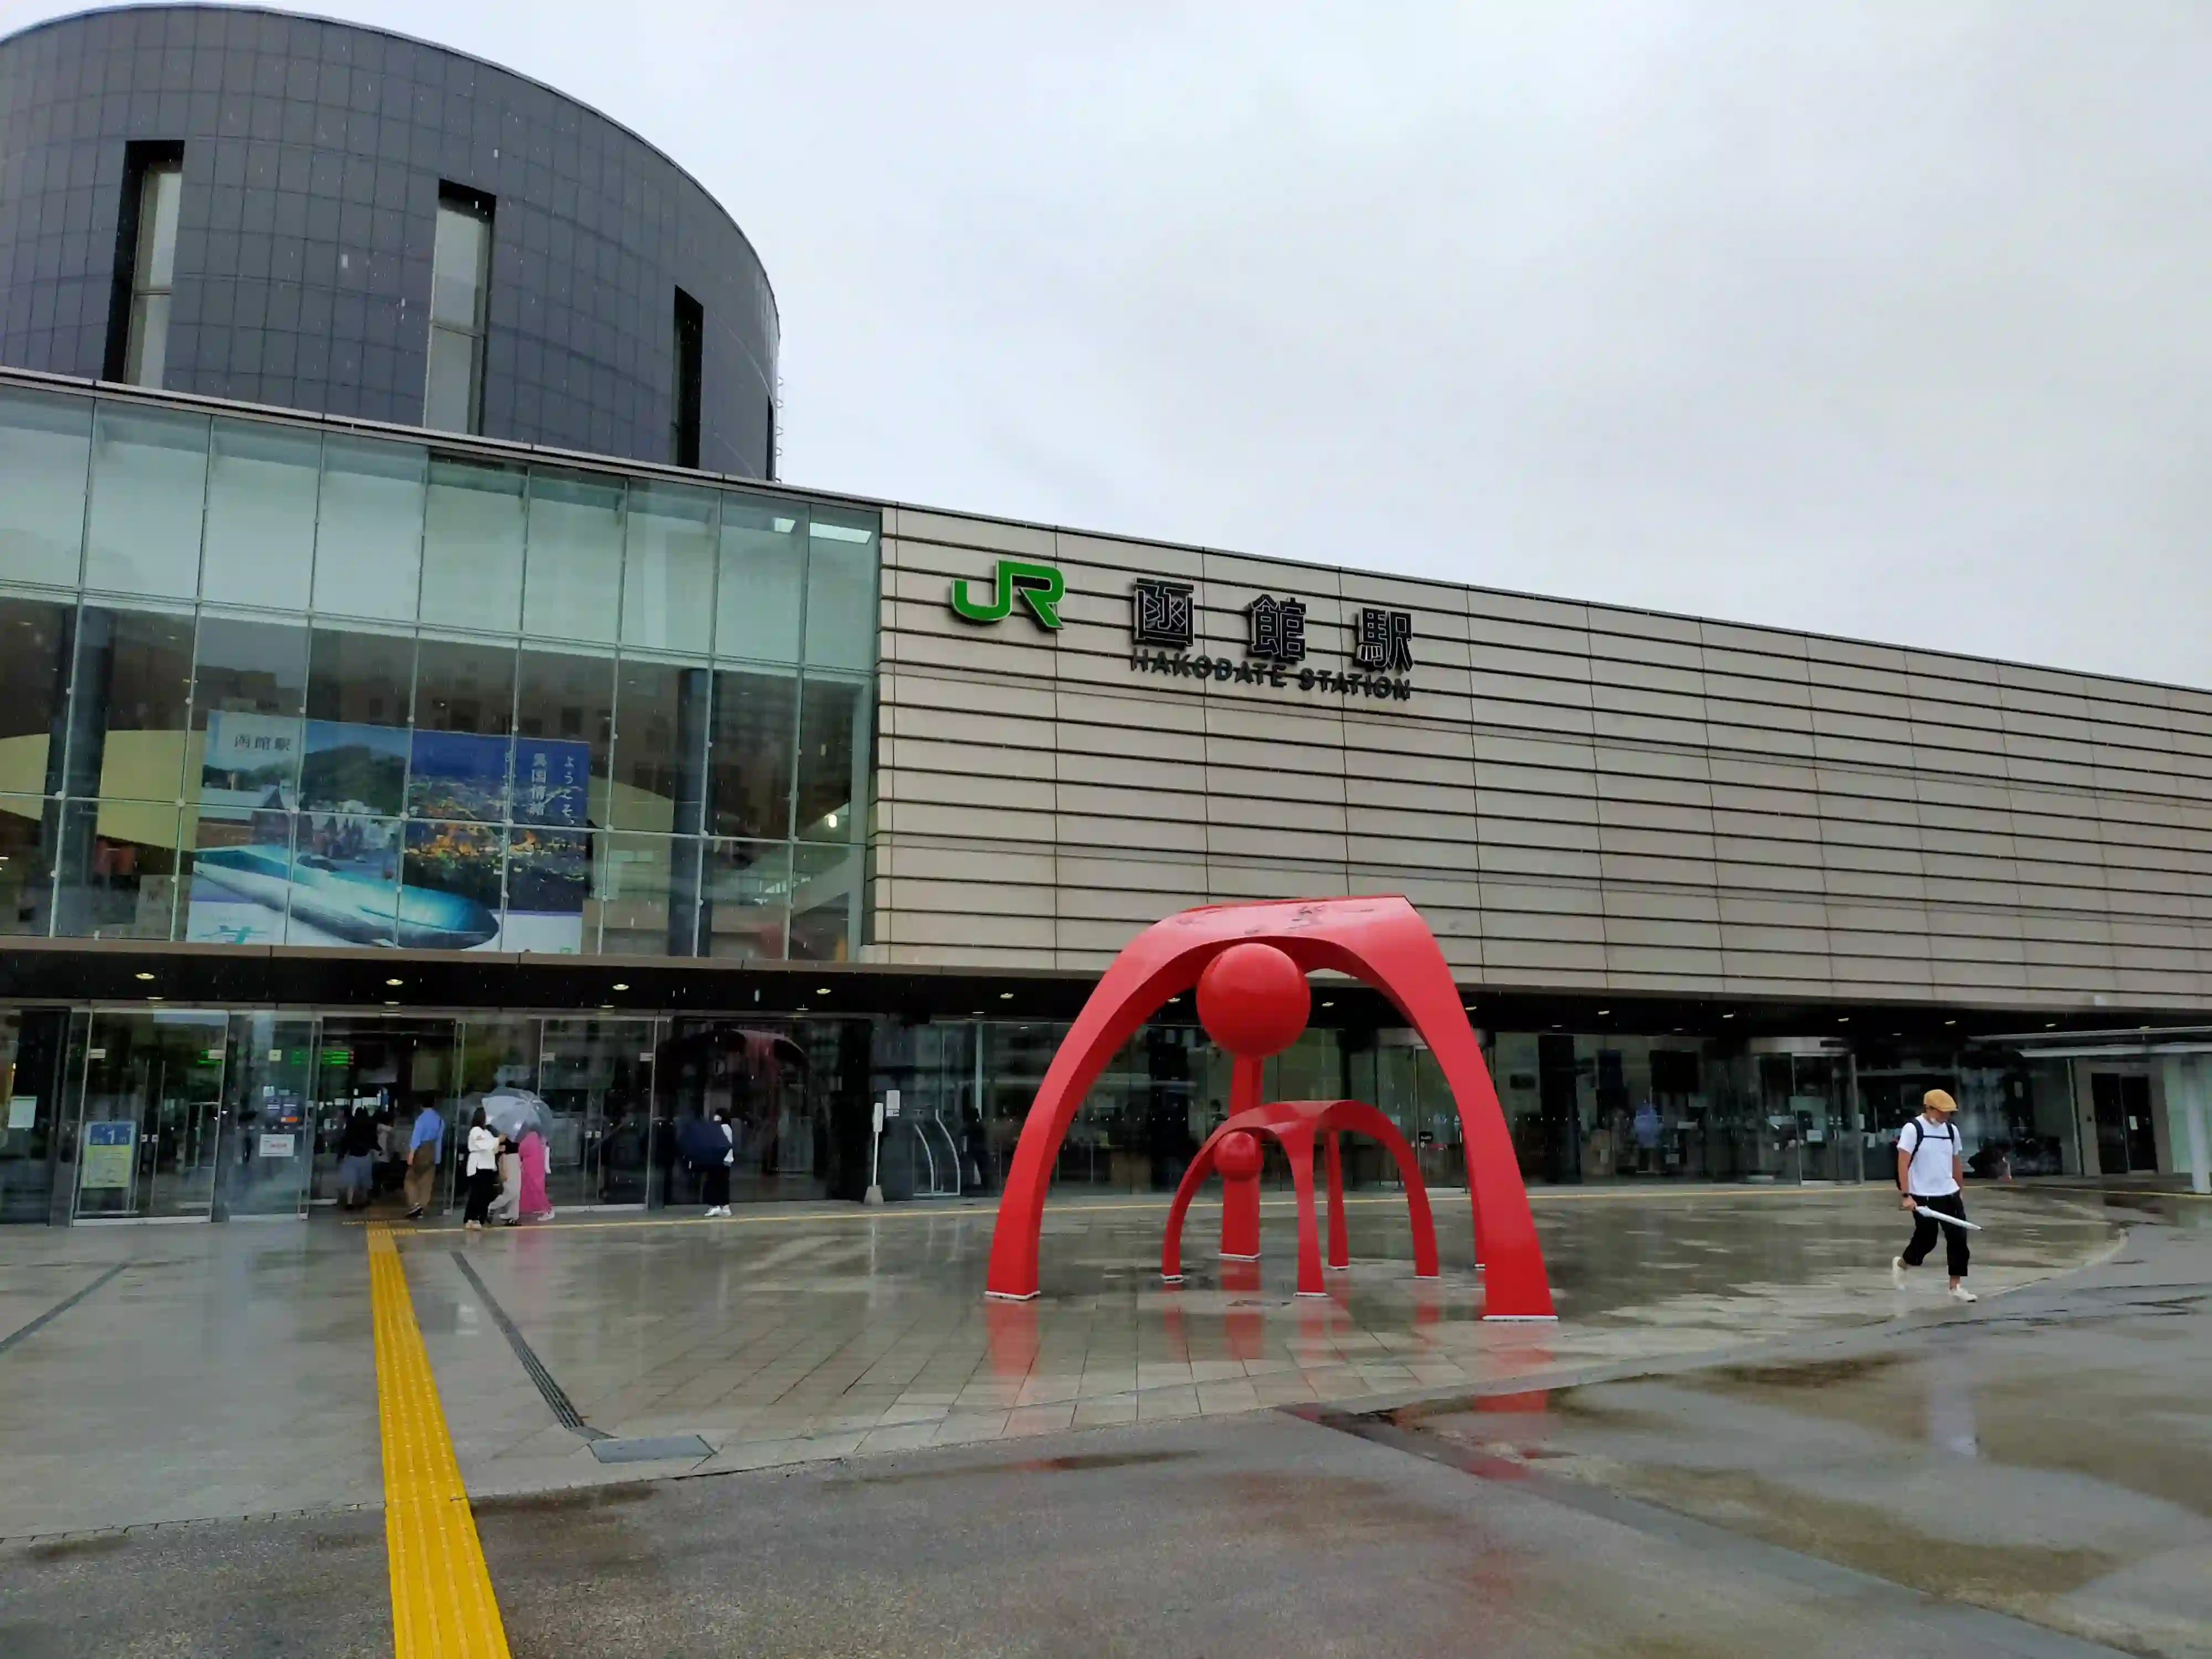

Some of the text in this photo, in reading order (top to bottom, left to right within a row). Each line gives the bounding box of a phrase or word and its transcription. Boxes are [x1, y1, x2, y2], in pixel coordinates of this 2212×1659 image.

[951, 560, 1065, 629] JR
[1133, 577, 1415, 672] 函館駅
[1130, 647, 1411, 701] HAKODATE STATION
